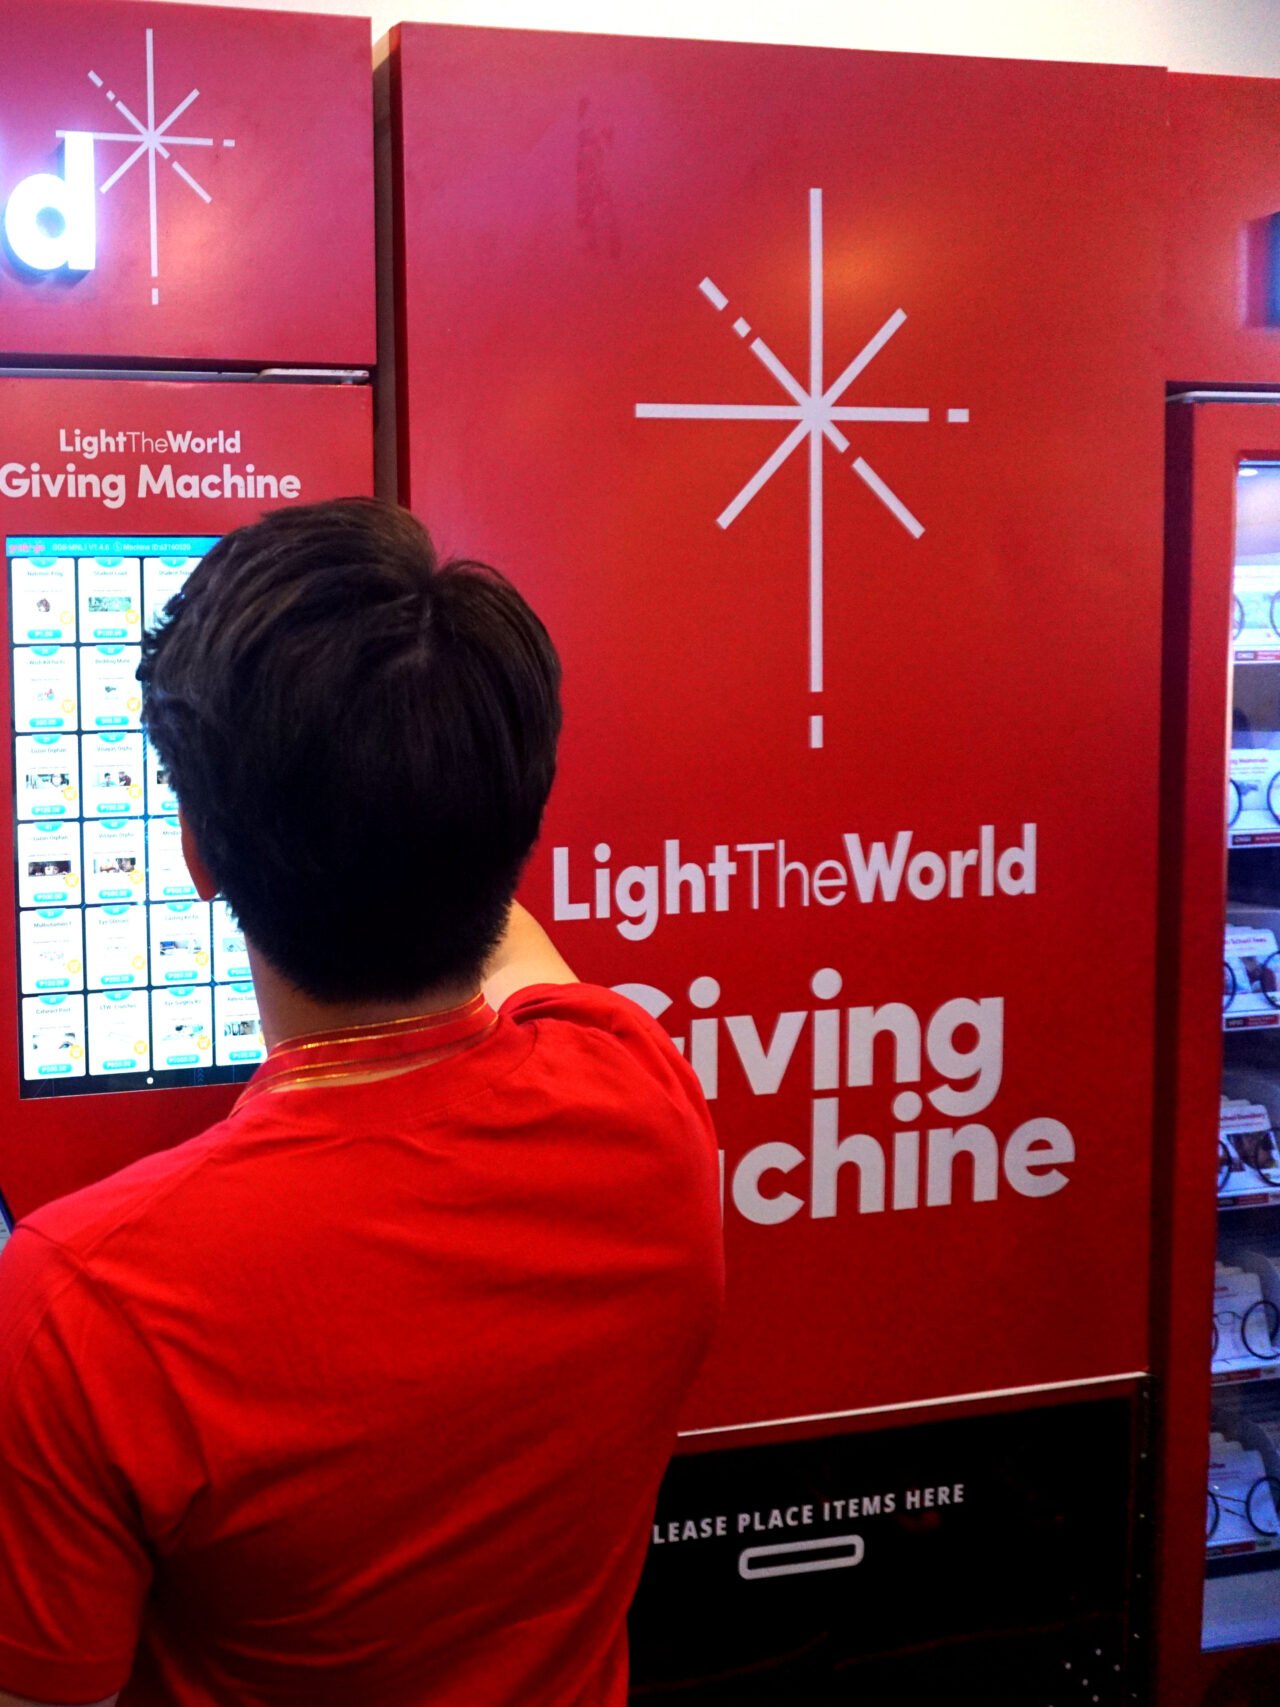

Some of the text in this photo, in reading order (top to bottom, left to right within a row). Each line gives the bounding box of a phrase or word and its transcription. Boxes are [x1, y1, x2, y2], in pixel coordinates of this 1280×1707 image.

[137, 464, 301, 498] Machine
[719, 1090, 1076, 1225] chine
[652, 1483, 965, 1544] LEASE PLACE ITEMS HERE
